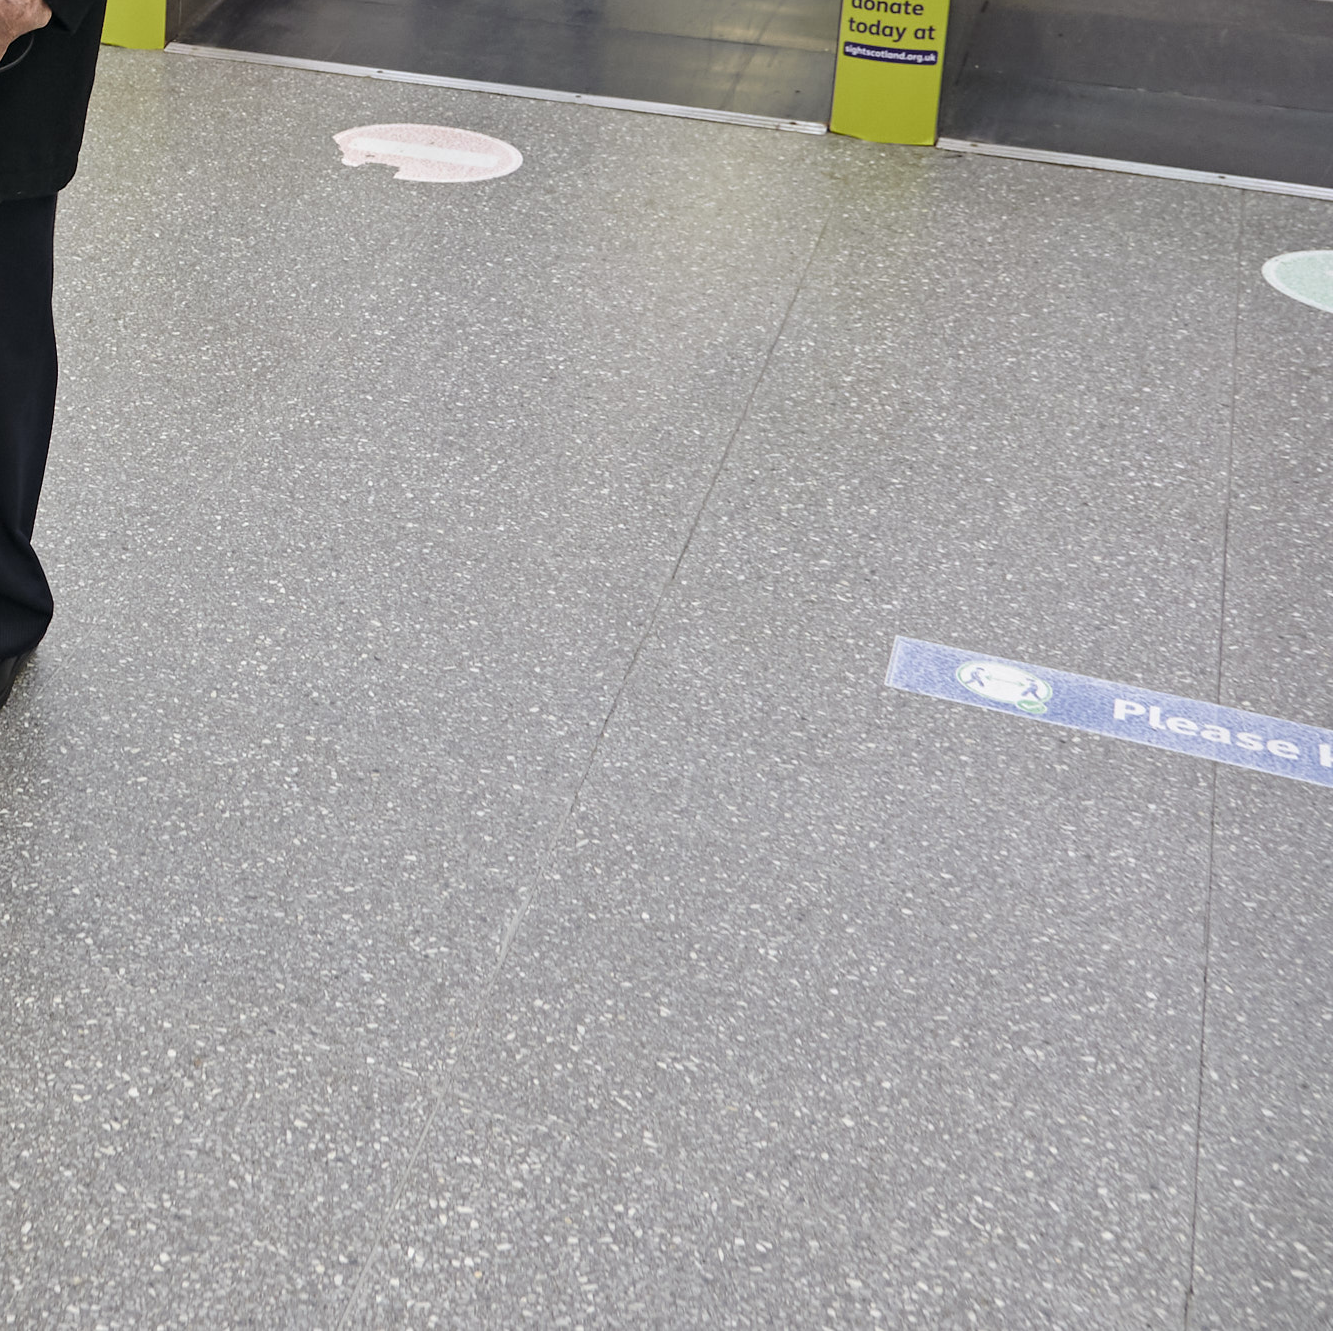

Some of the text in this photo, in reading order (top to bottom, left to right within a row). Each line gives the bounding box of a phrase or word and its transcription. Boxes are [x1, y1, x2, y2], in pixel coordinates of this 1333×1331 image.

[848, 17, 936, 43] today at
[845, 44, 936, 63] sightscotland.org.uk
[1113, 698, 1300, 761] Please
